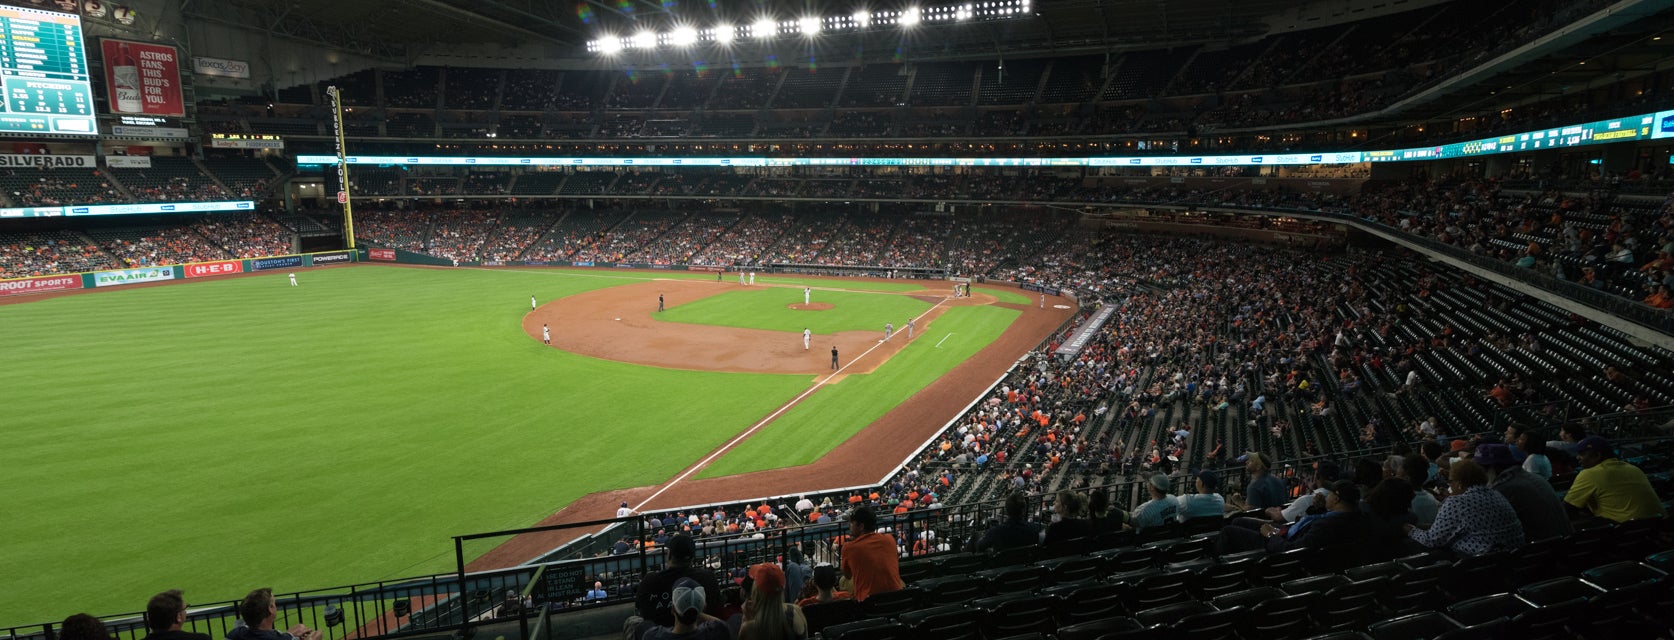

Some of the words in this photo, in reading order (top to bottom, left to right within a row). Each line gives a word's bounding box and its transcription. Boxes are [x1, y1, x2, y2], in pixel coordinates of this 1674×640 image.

[140, 51, 173, 62] ASTROS
[142, 60, 166, 70] FANS,
[142, 68, 162, 78] THIS
[144, 78, 170, 87] BUD'S
[144, 86, 162, 94] FOR
[146, 95, 166, 104] YOU.
[0, 156, 84, 167] SILVERADO
[0, 280, 33, 290] ROOT
[35, 278, 73, 287] SPORTS
